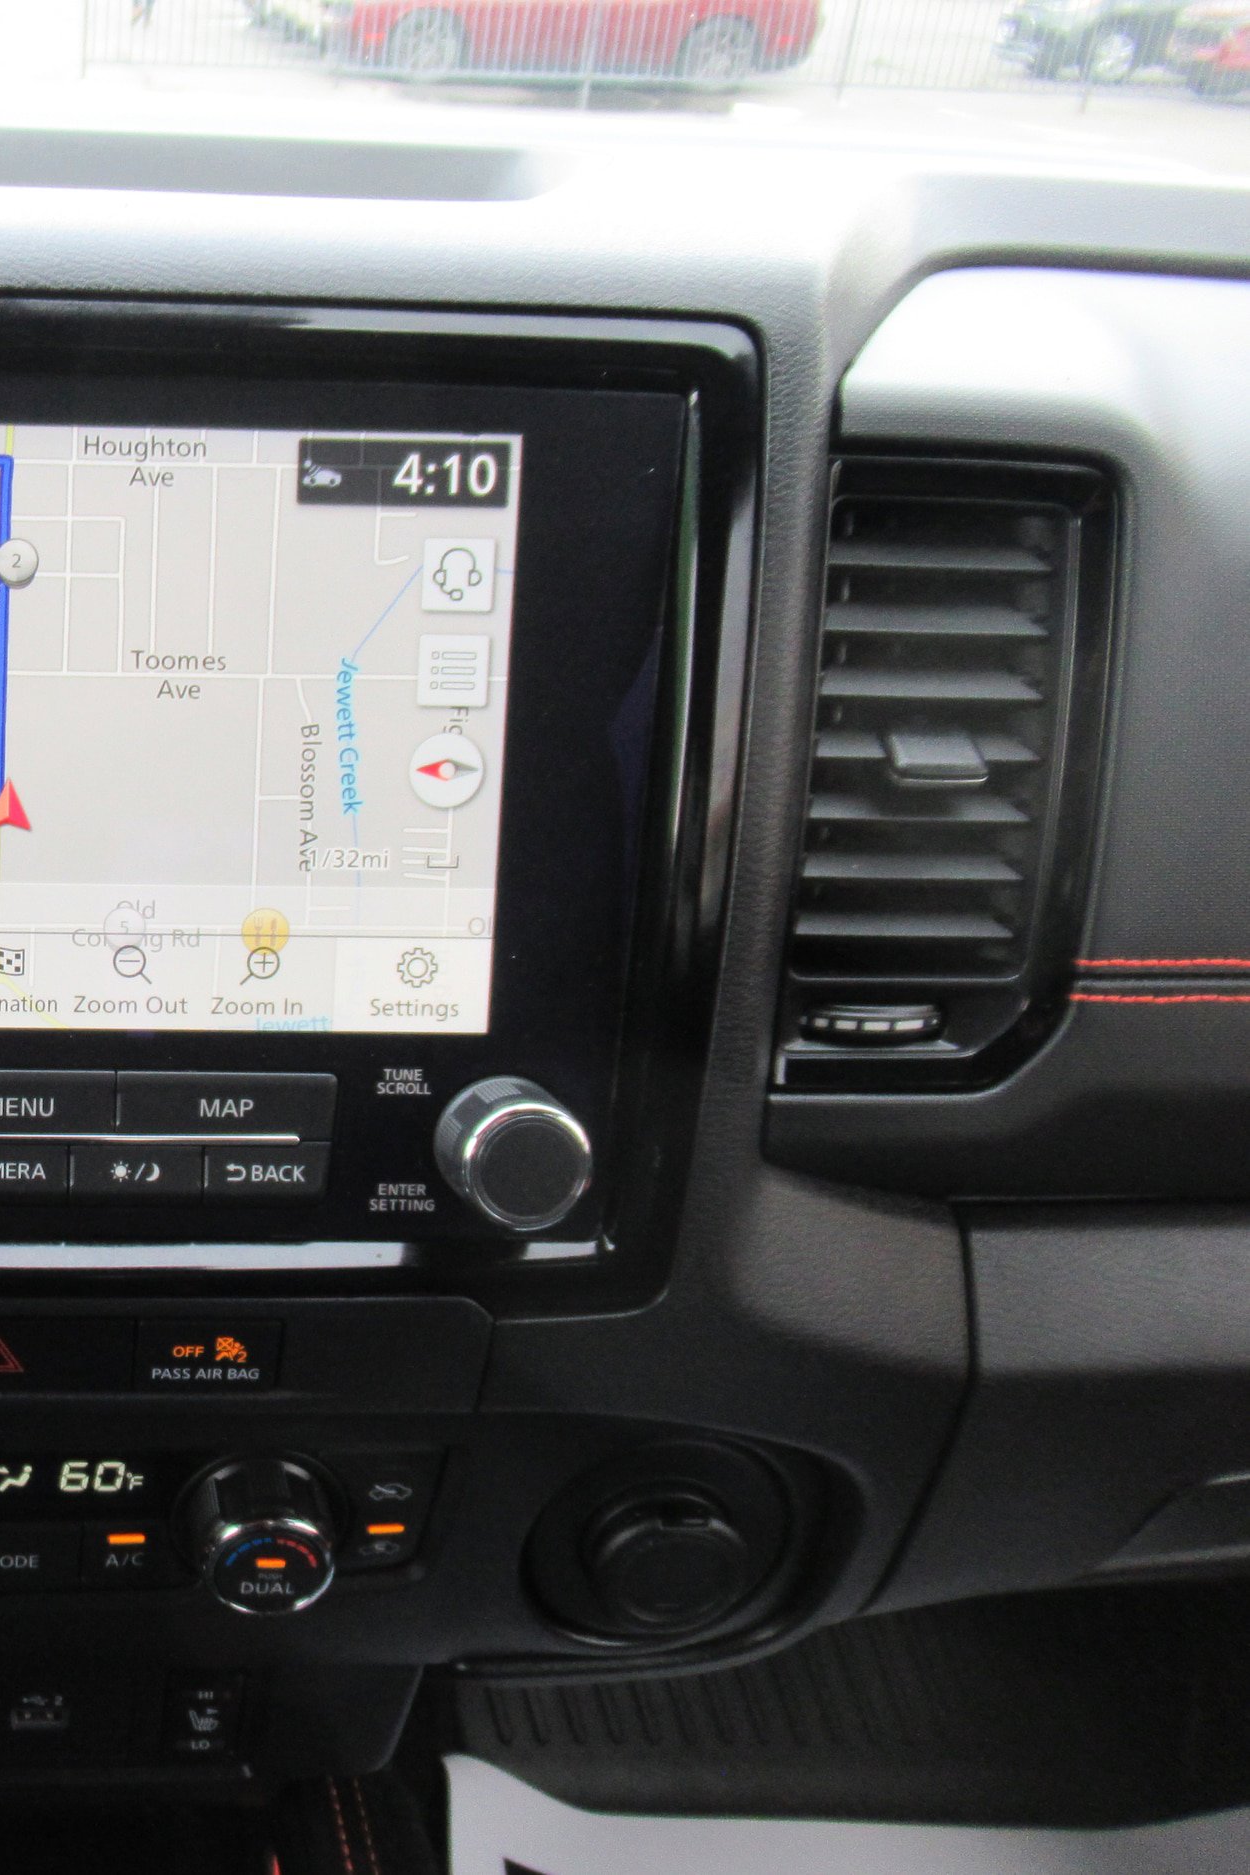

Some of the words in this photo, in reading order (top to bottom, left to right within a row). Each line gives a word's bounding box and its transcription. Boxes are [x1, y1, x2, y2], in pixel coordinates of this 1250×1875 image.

[83, 434, 207, 464] Houghton
[129, 467, 175, 488] Ave
[393, 452, 496, 497] 4:10
[11, 553, 22, 569] 2
[131, 649, 227, 672] Toomes
[156, 679, 201, 700] Ave
[336, 657, 359, 742] Jewett
[299, 723, 323, 821] Blossom
[339, 747, 364, 816] Creek
[172, 928, 200, 948] Rd
[73, 996, 138, 1014] Zoom
[146, 996, 188, 1015] Out
[211, 998, 277, 1015] Zoom
[283, 998, 303, 1016] In
[370, 998, 459, 1022] Settings
[383, 1068, 423, 1082] TUNE
[376, 1081, 431, 1095] SCROLL
[199, 1098, 254, 1118] MAP
[251, 1164, 306, 1183] BACK
[378, 1183, 427, 1197] ENTER
[368, 1198, 435, 1212] SETTING
[172, 1345, 205, 1359] OFF
[151, 1367, 191, 1381] PASS
[195, 1367, 222, 1381] AIR
[227, 1367, 260, 1381] BAG
[105, 1552, 144, 1568] A/C
[239, 1580, 295, 1596] DUAL
